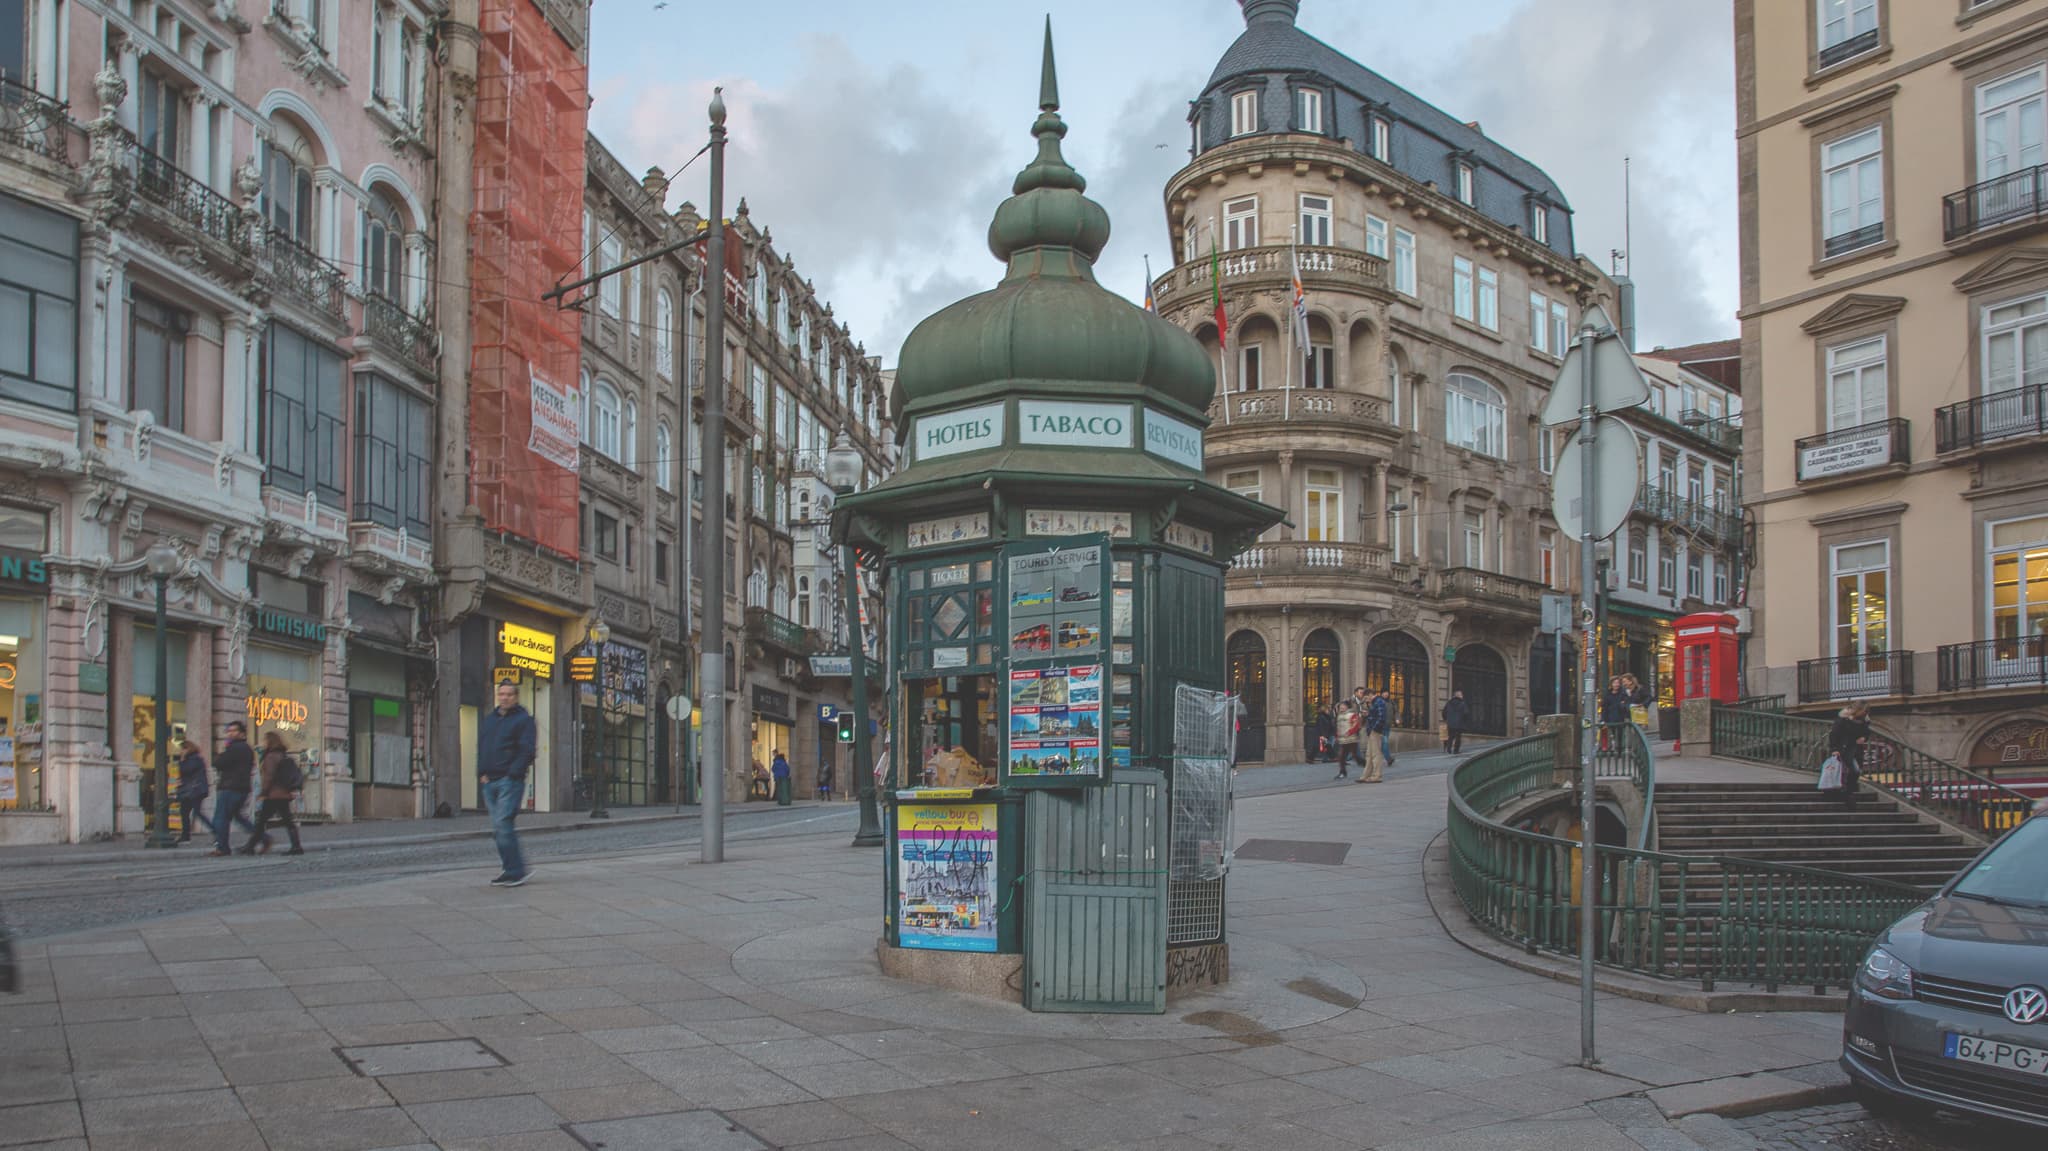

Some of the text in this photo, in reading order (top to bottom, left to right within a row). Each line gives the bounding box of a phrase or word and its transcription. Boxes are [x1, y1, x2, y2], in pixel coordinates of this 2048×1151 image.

[534, 400, 578, 438] ANDAIMES
[927, 418, 992, 447] HOTELS
[1027, 414, 1122, 436] TABACO
[1148, 423, 1198, 457] REVISTAS
[1823, 458, 1865, 472] ADVOGADOS
[1015, 550, 1098, 569] TOURIST SERVICE
[256, 610, 326, 641] TURISMO
